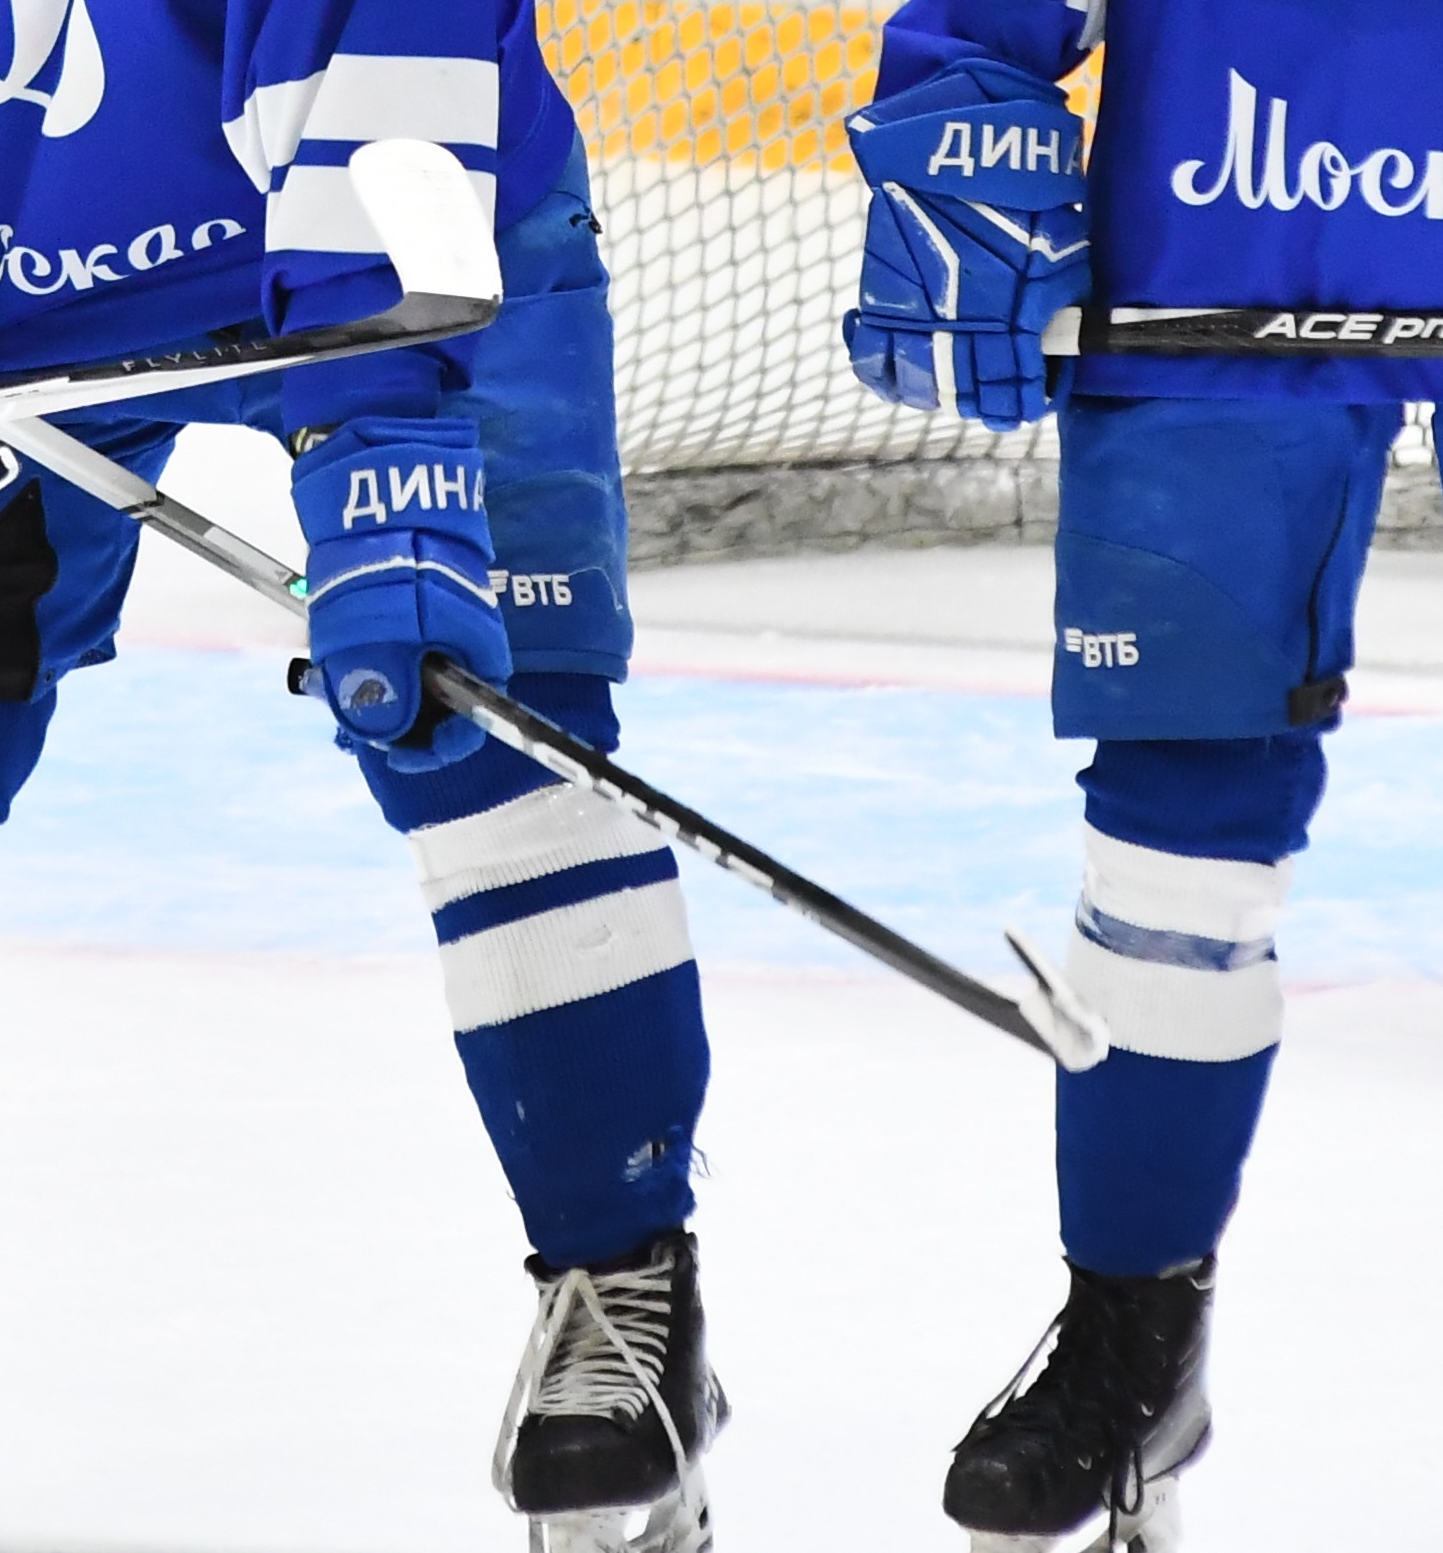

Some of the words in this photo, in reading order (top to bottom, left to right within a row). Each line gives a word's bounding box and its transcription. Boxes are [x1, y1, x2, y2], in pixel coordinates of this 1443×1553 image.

[1255, 312, 1384, 340] ACE
[512, 573, 573, 606] ВТБ
[1082, 633, 1140, 667] ВТБ
